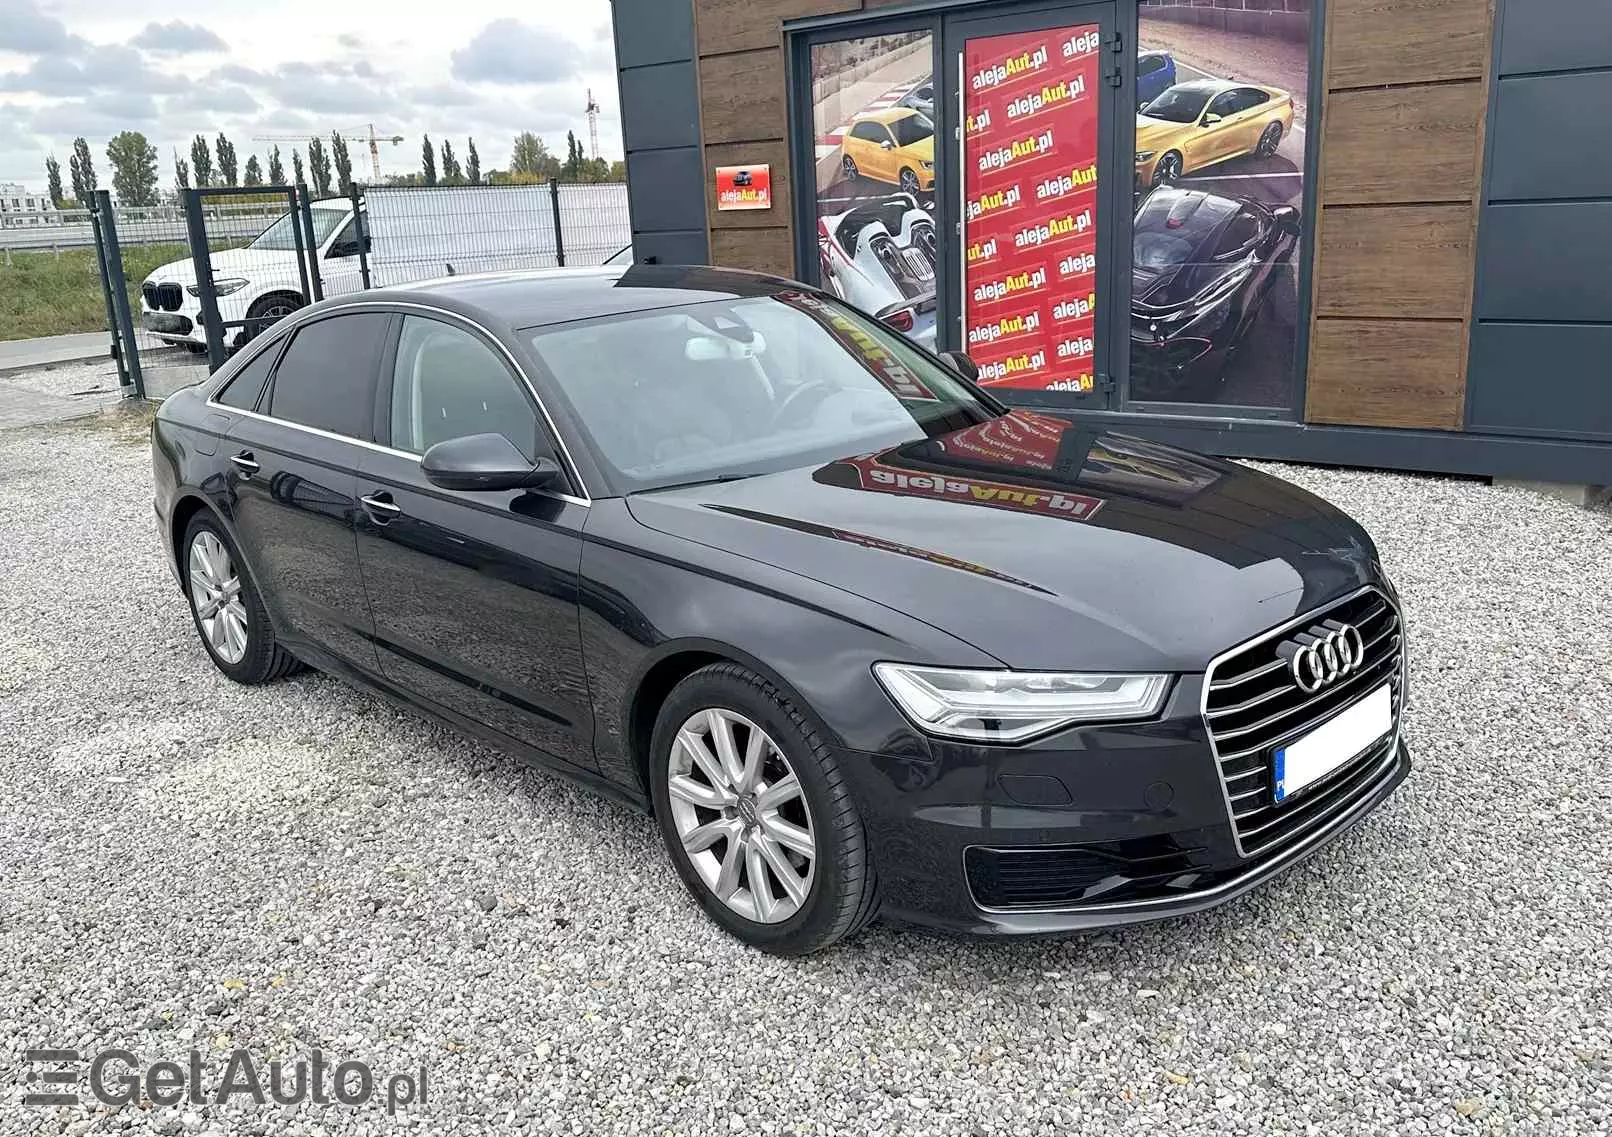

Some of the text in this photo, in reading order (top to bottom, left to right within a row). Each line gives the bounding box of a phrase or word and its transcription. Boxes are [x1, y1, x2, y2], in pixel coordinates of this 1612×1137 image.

[972, 45, 1048, 89] alejaAut.pl
[1007, 75, 1085, 118] alejaAut.pl
[978, 130, 1054, 170] alejaAut.pl
[721, 187, 767, 204] alejaAut.pl
[967, 185, 1021, 220] jaAut.pl
[1015, 210, 1091, 247] alejaAut.pl
[974, 268, 1046, 302] alejaAut.pl
[969, 311, 1040, 343] alejaAut.pl
